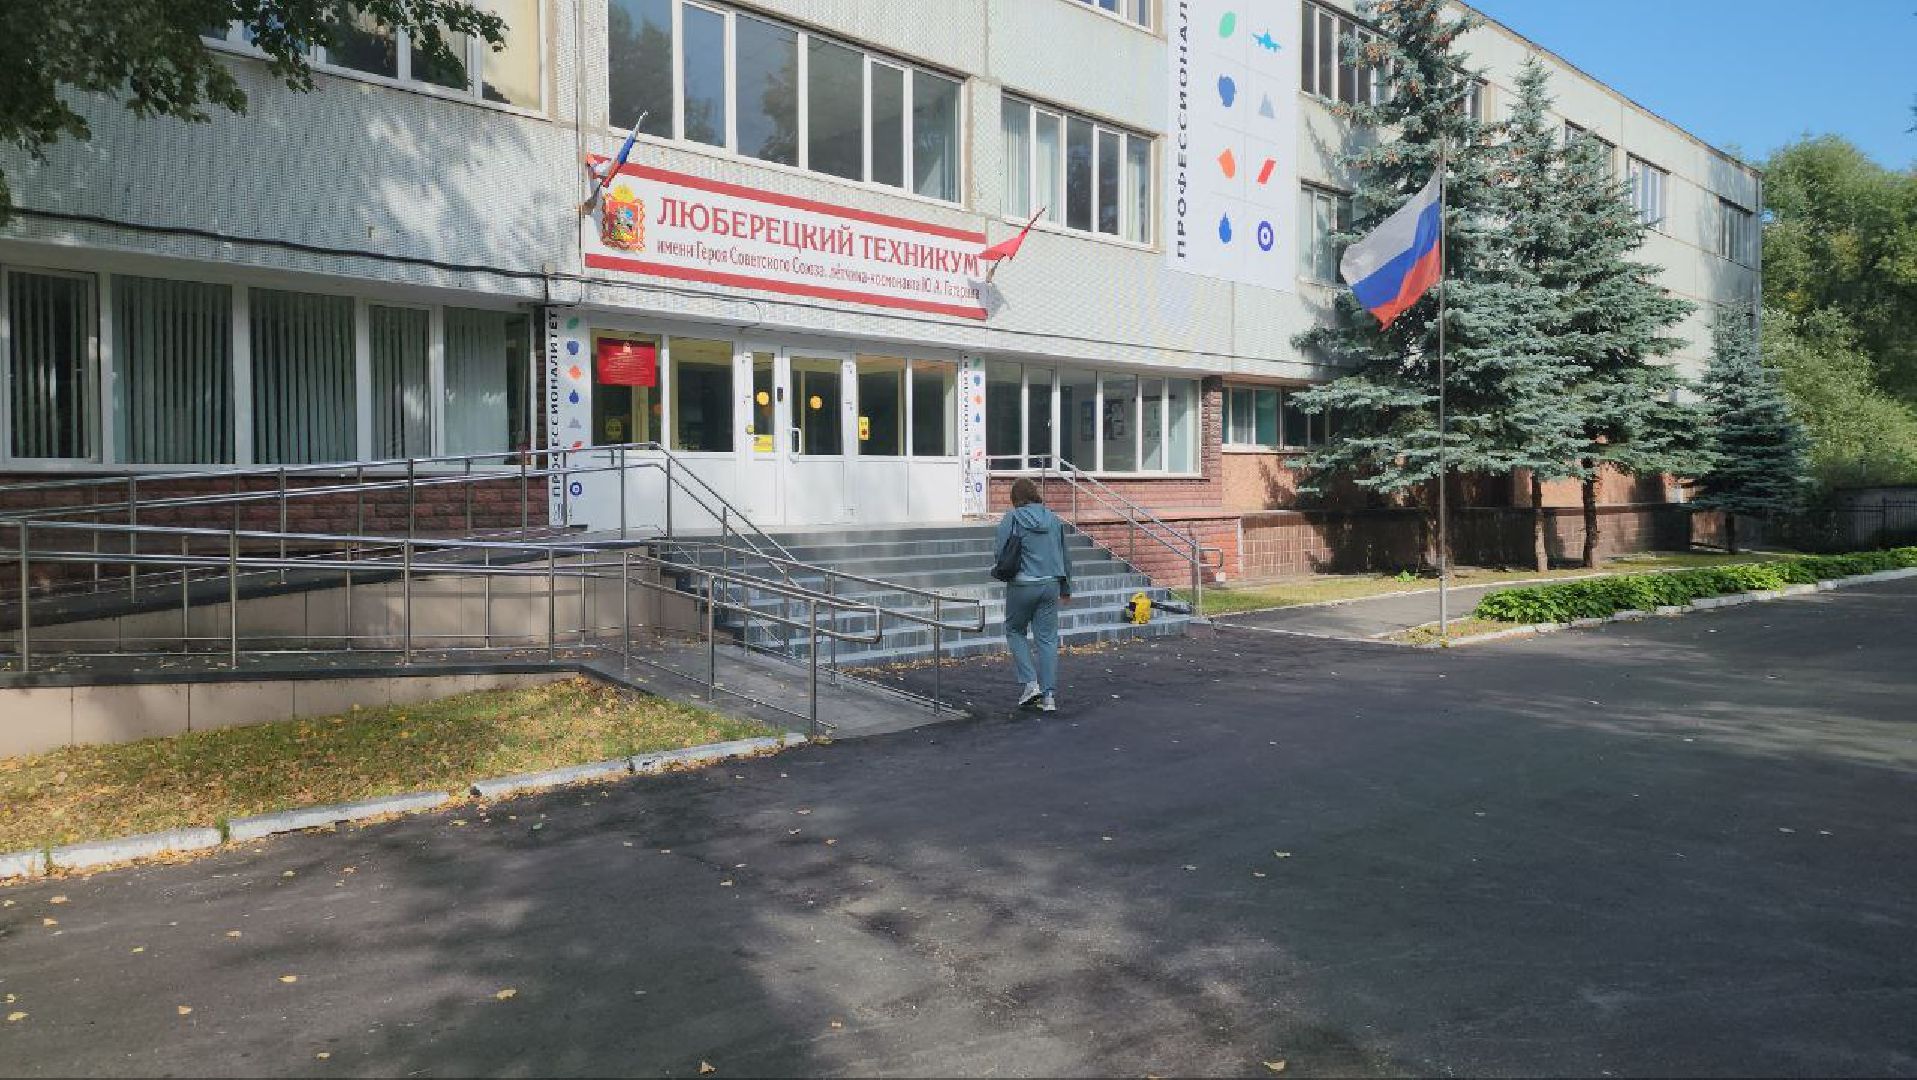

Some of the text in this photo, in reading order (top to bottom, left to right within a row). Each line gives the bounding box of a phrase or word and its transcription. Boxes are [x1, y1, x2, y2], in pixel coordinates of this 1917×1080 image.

[1177, 1, 1188, 258] ПРОФЕССИОНАЛ
[656, 197, 980, 277] ЛЮБЕРЕЦКИЙ ТЕХНИКУМ
[656, 239, 693, 258] имени
[696, 240, 728, 265] Героя
[730, 246, 790, 272] Советского
